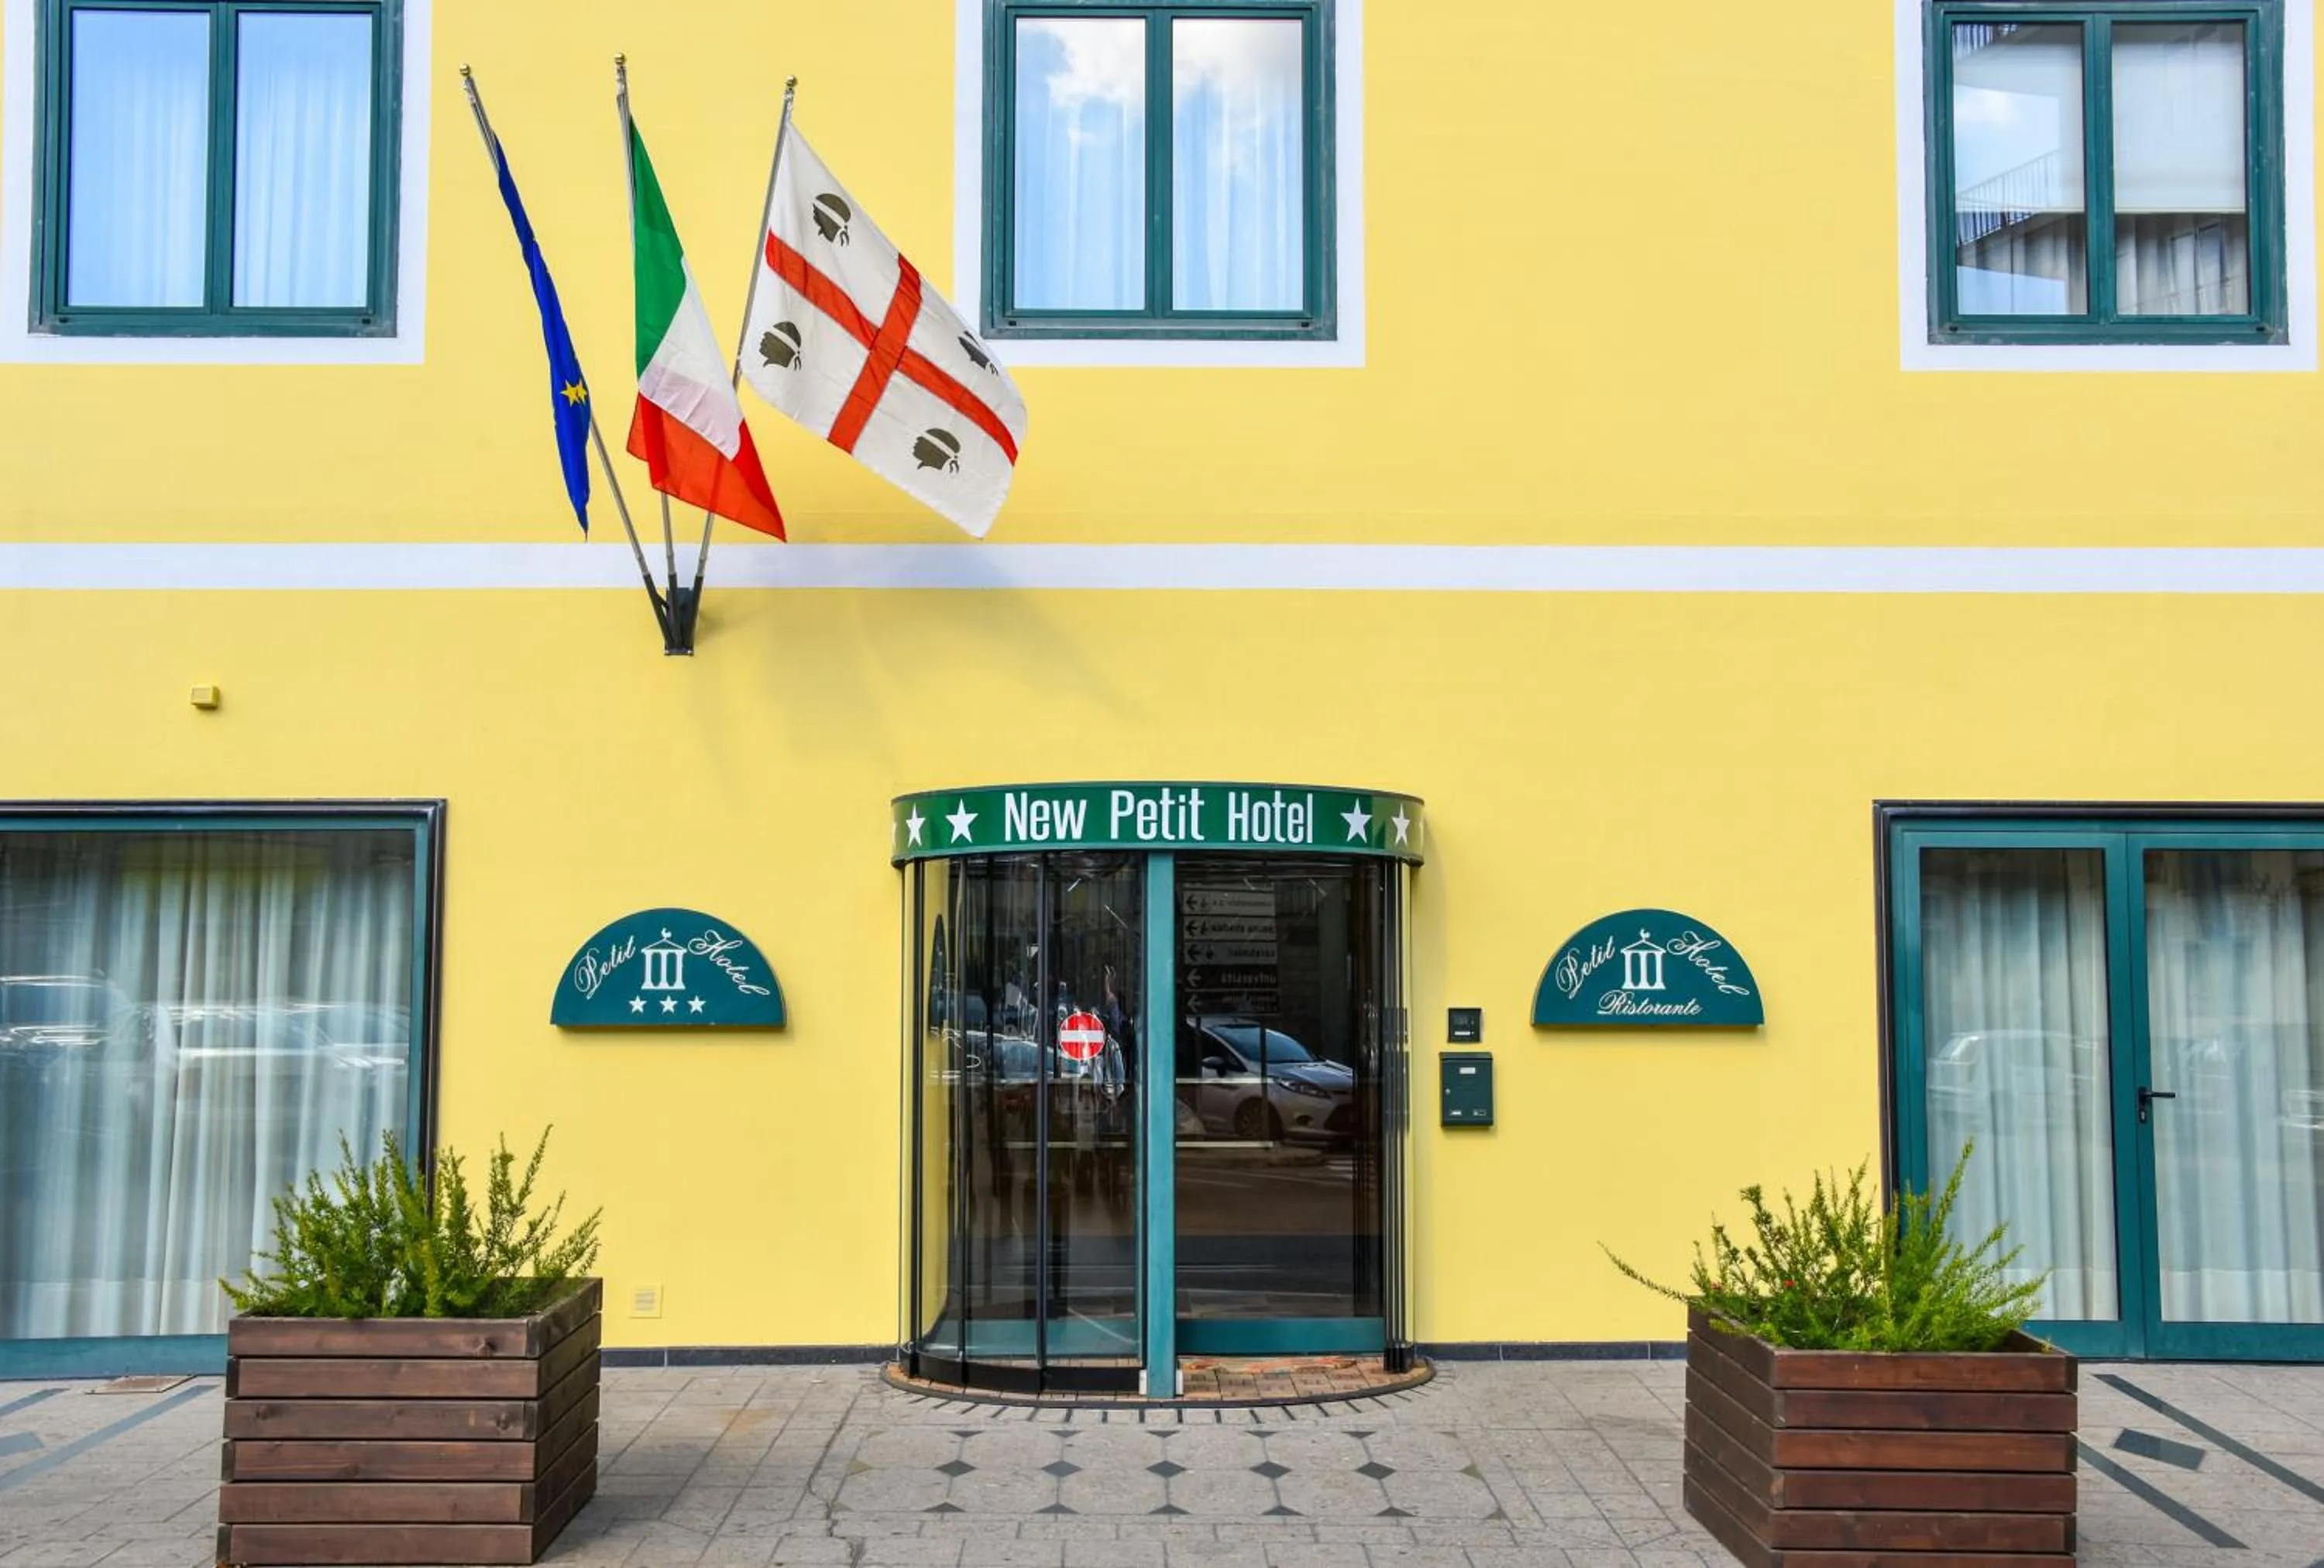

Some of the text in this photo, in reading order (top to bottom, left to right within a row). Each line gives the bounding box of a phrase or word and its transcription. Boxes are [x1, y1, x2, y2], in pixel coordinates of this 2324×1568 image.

[1005, 788, 1314, 844] New Petit Hotel
[574, 929, 771, 999] Petit Hotel
[1556, 930, 1750, 999] Petit Hotel
[1597, 989, 1703, 1016] Ristorante
